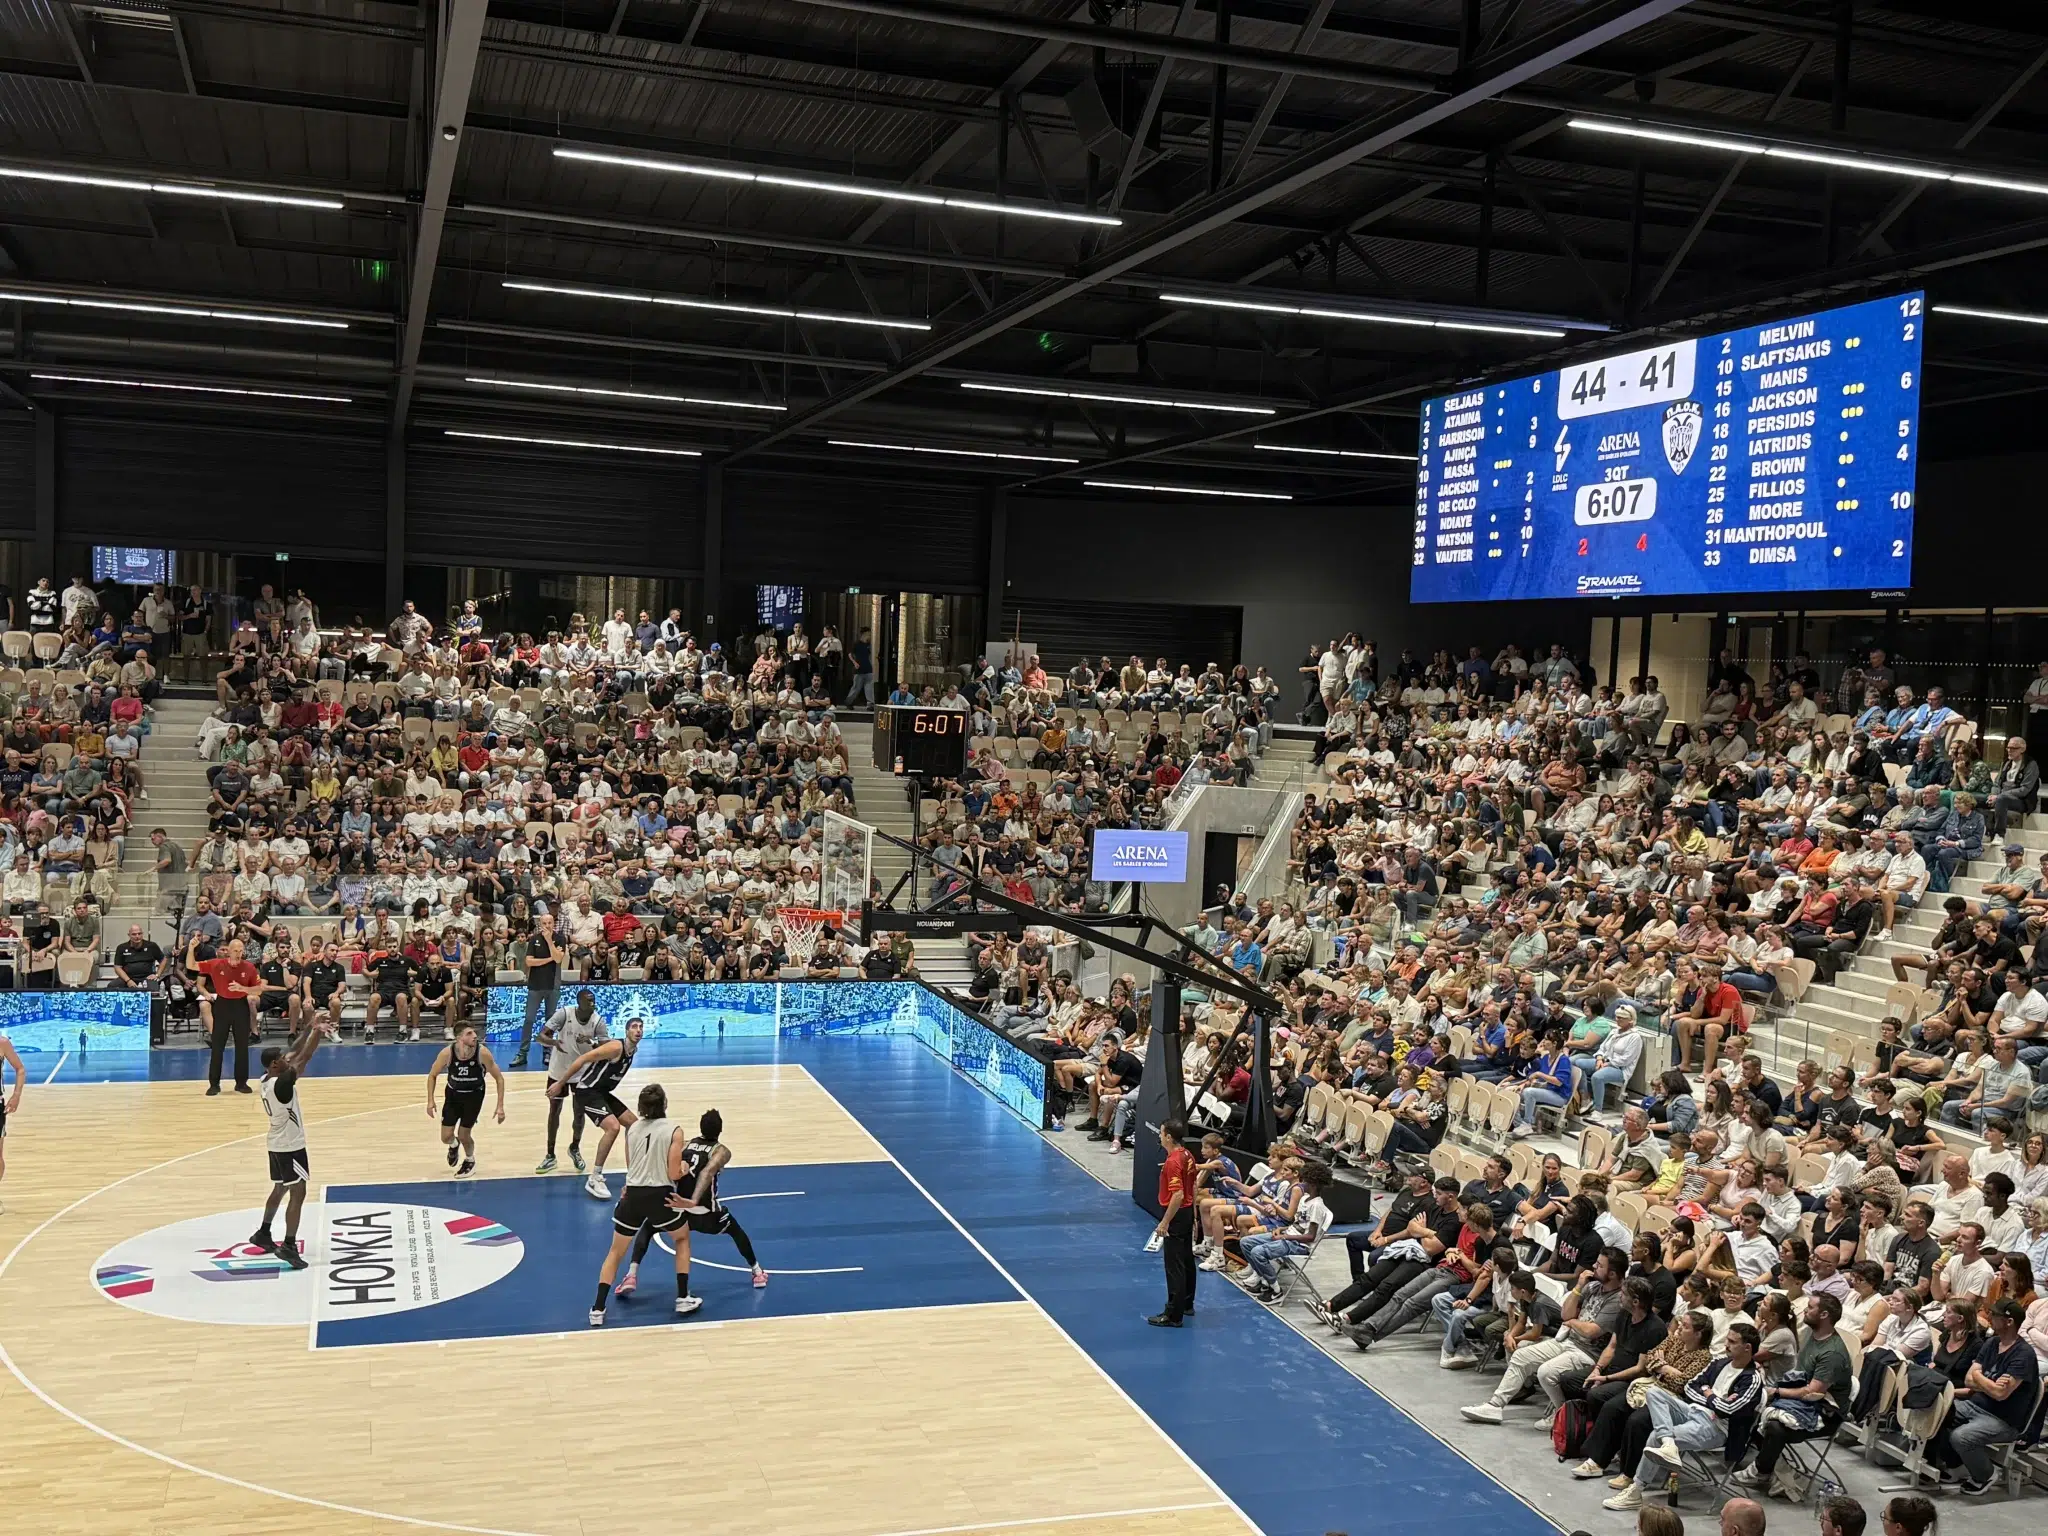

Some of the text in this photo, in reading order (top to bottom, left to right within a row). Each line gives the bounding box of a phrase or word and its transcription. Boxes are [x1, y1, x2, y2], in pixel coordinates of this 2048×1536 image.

[1721, 298, 1921, 354] 2 MELVIN 12
[1717, 323, 1915, 376] 10 SLAFTSAKIS 2
[1571, 366, 1606, 405] 44
[1640, 351, 1676, 391] 41
[1715, 367, 1808, 397] 15 MANIS
[1425, 379, 1541, 417] 1 SELJAAS 6
[1714, 372, 1912, 419] 16 JACKSON 6
[1422, 416, 1538, 450] 3 HARRISON 3
[1423, 411, 1481, 433] 2 ATAMNA
[1713, 410, 1815, 440] 18 PERSIDIS
[1444, 446, 1477, 462] AJINÇA
[1529, 435, 1537, 448] 9
[1597, 431, 1640, 452] ARENA
[1710, 420, 1910, 461] 20 IATRIDIS 5
[1419, 463, 1475, 483] 10 MASSA
[1604, 465, 1630, 482] 3QT
[1709, 444, 1909, 482] 22 BROWN 4
[1418, 471, 1534, 499] 11 JACKSON 2
[1708, 478, 1805, 503] 25 FILLIOS
[1417, 489, 1533, 516] 12 DE COLO 4
[1587, 484, 1644, 518] 6:07
[1706, 492, 1911, 524] 26 MOORE 10
[1415, 508, 1531, 532] 24 NDIAYE 3
[1414, 525, 1533, 549] 30 WATSON 10
[1577, 533, 1647, 556] 2 4
[1705, 522, 1828, 545] 31 MANTHOPOUL
[1413, 544, 1529, 565] 32 VAUTIER 7
[1704, 540, 1904, 566] 33 DIMSA 2
[1576, 575, 1642, 590] STRAMATEL
[914, 713, 964, 734] 6:07
[1112, 845, 1168, 861] ARENA
[458, 1067, 469, 1076] 25
[645, 1133, 652, 1155] 1
